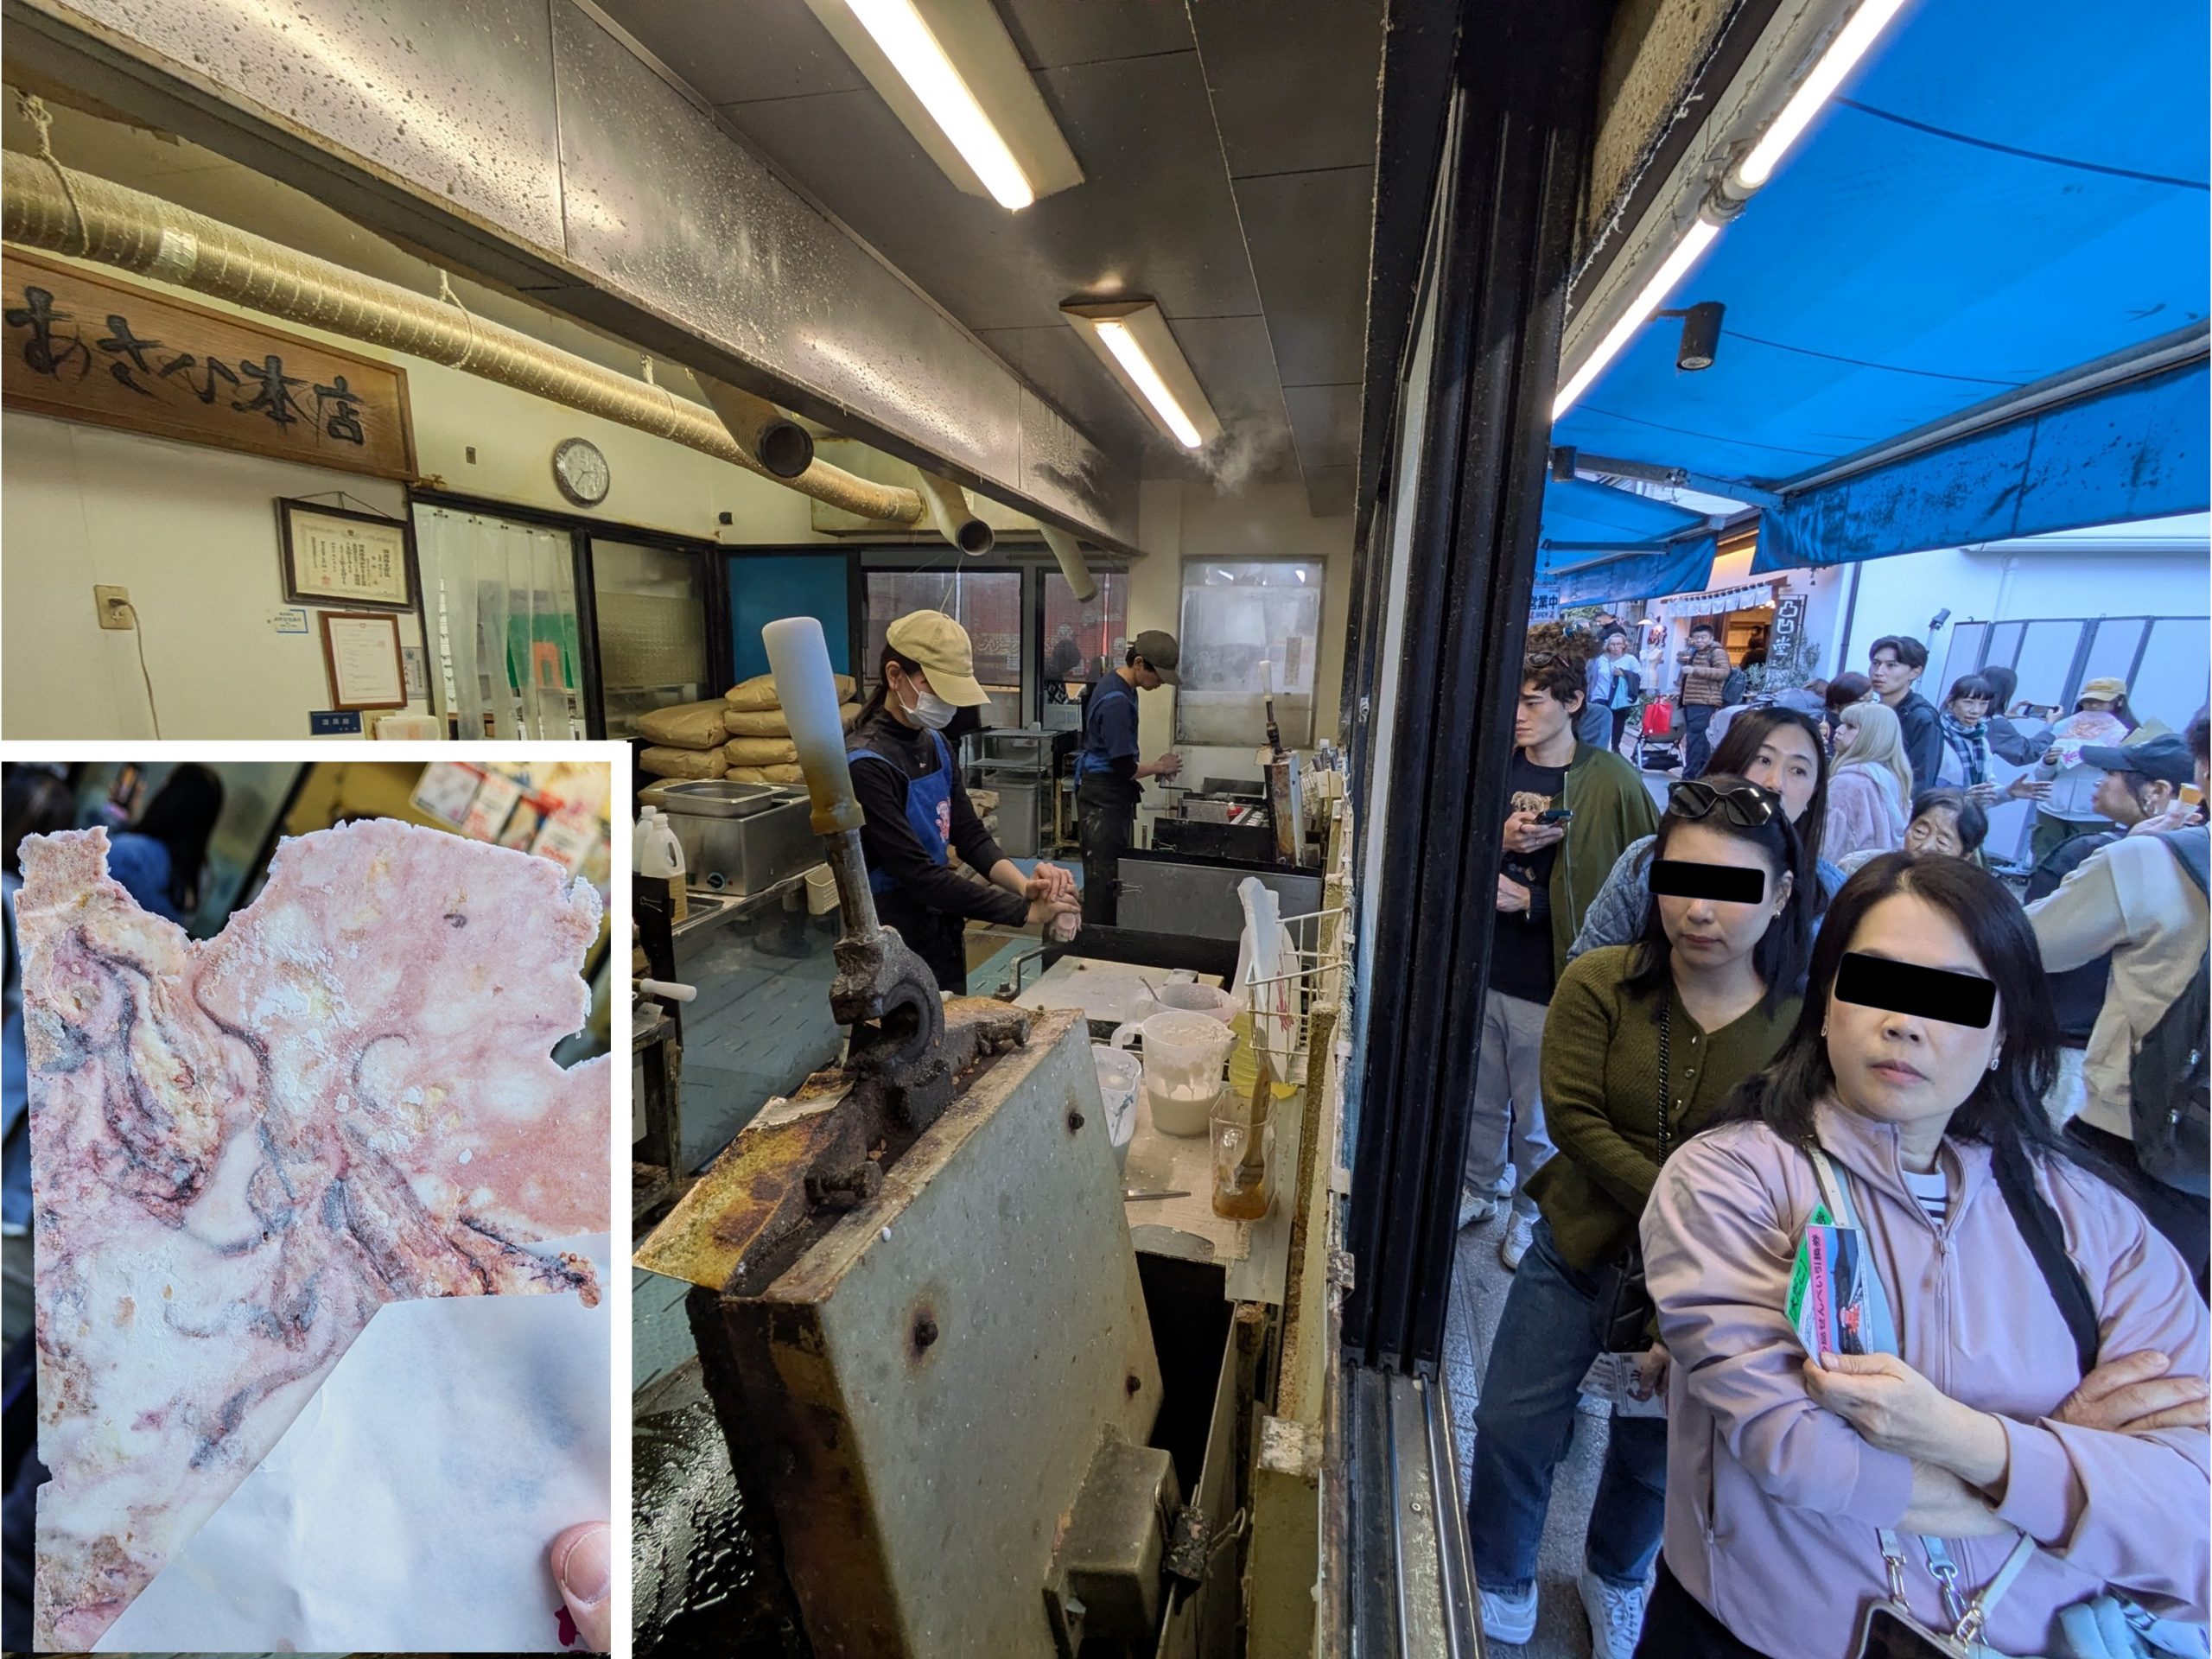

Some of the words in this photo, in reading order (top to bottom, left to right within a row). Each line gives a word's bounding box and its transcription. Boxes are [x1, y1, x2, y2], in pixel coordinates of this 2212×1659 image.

[5, 285, 365, 446] あさひ本店
[1530, 594, 1558, 610] 営業中
[1772, 600, 1798, 656] 凸凹堂
